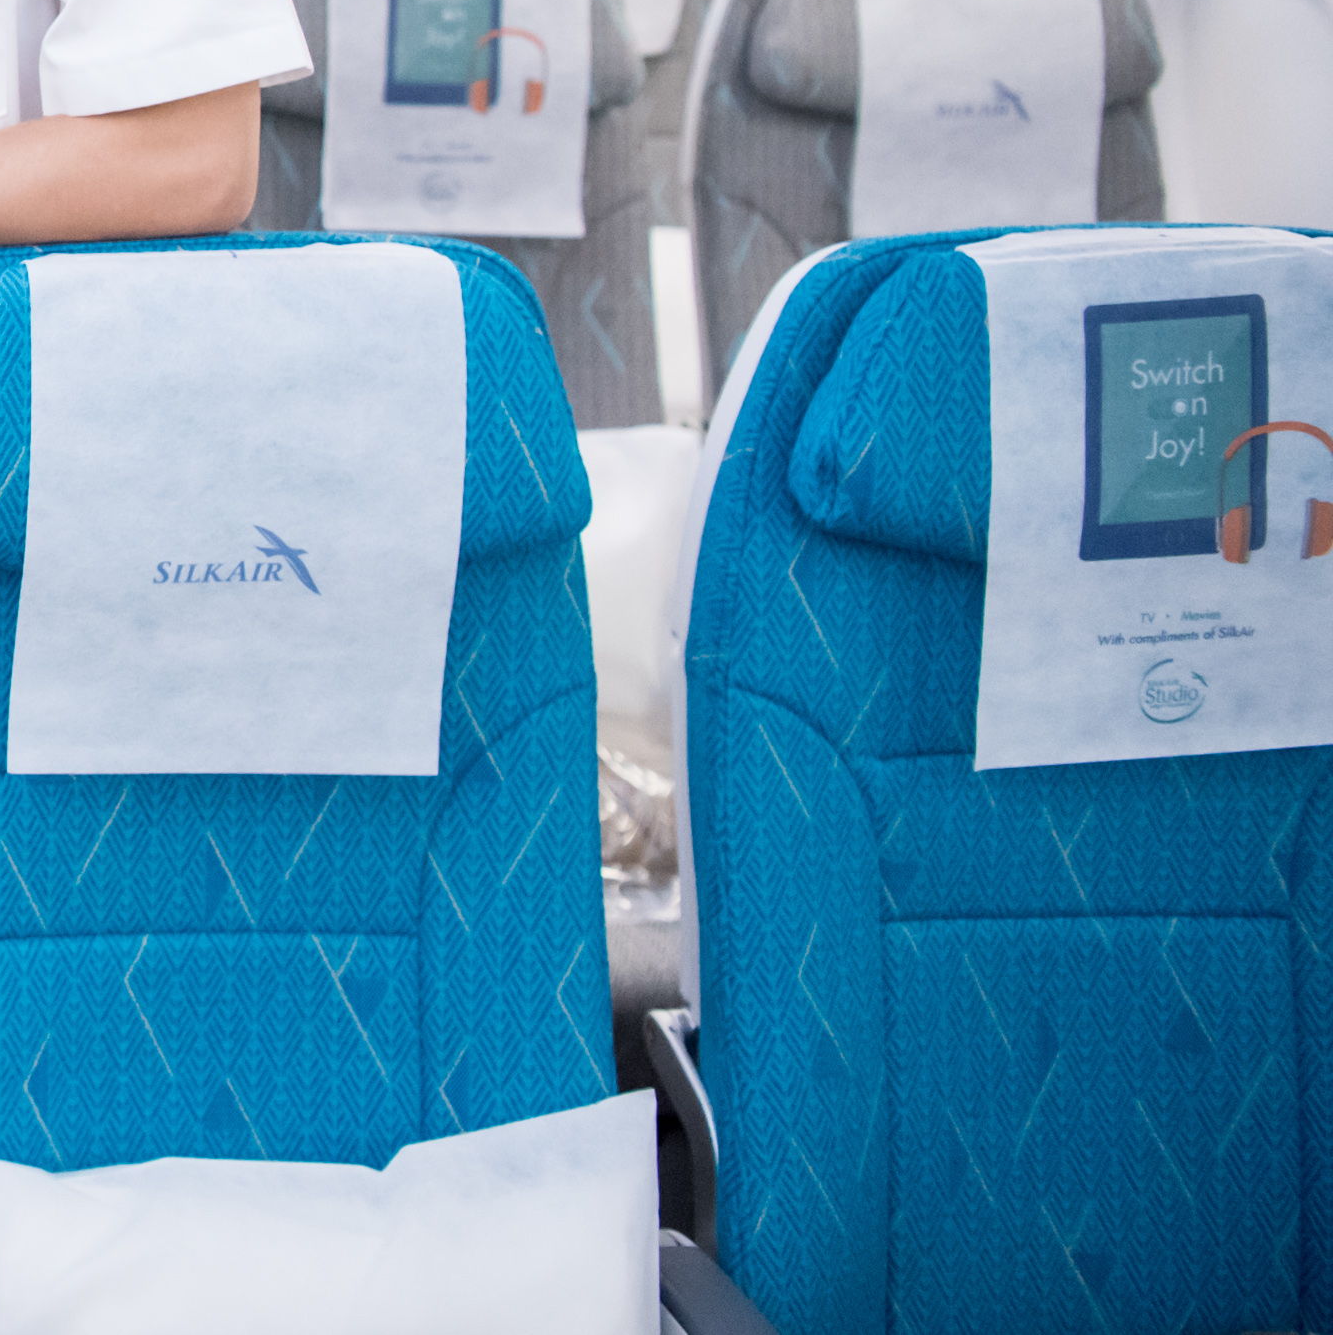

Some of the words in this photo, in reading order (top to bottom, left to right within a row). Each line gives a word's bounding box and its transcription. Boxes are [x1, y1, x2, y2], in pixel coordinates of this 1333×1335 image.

[1132, 350, 1223, 389] Switch
[1145, 426, 1204, 466] Joy!
[1140, 612, 1156, 624] TV
[1098, 633, 1125, 645] With
[1129, 629, 1200, 646] compliments
[1202, 627, 1215, 640] of
[1218, 625, 1256, 639] SilkAir
[1145, 684, 1199, 704] Studio
